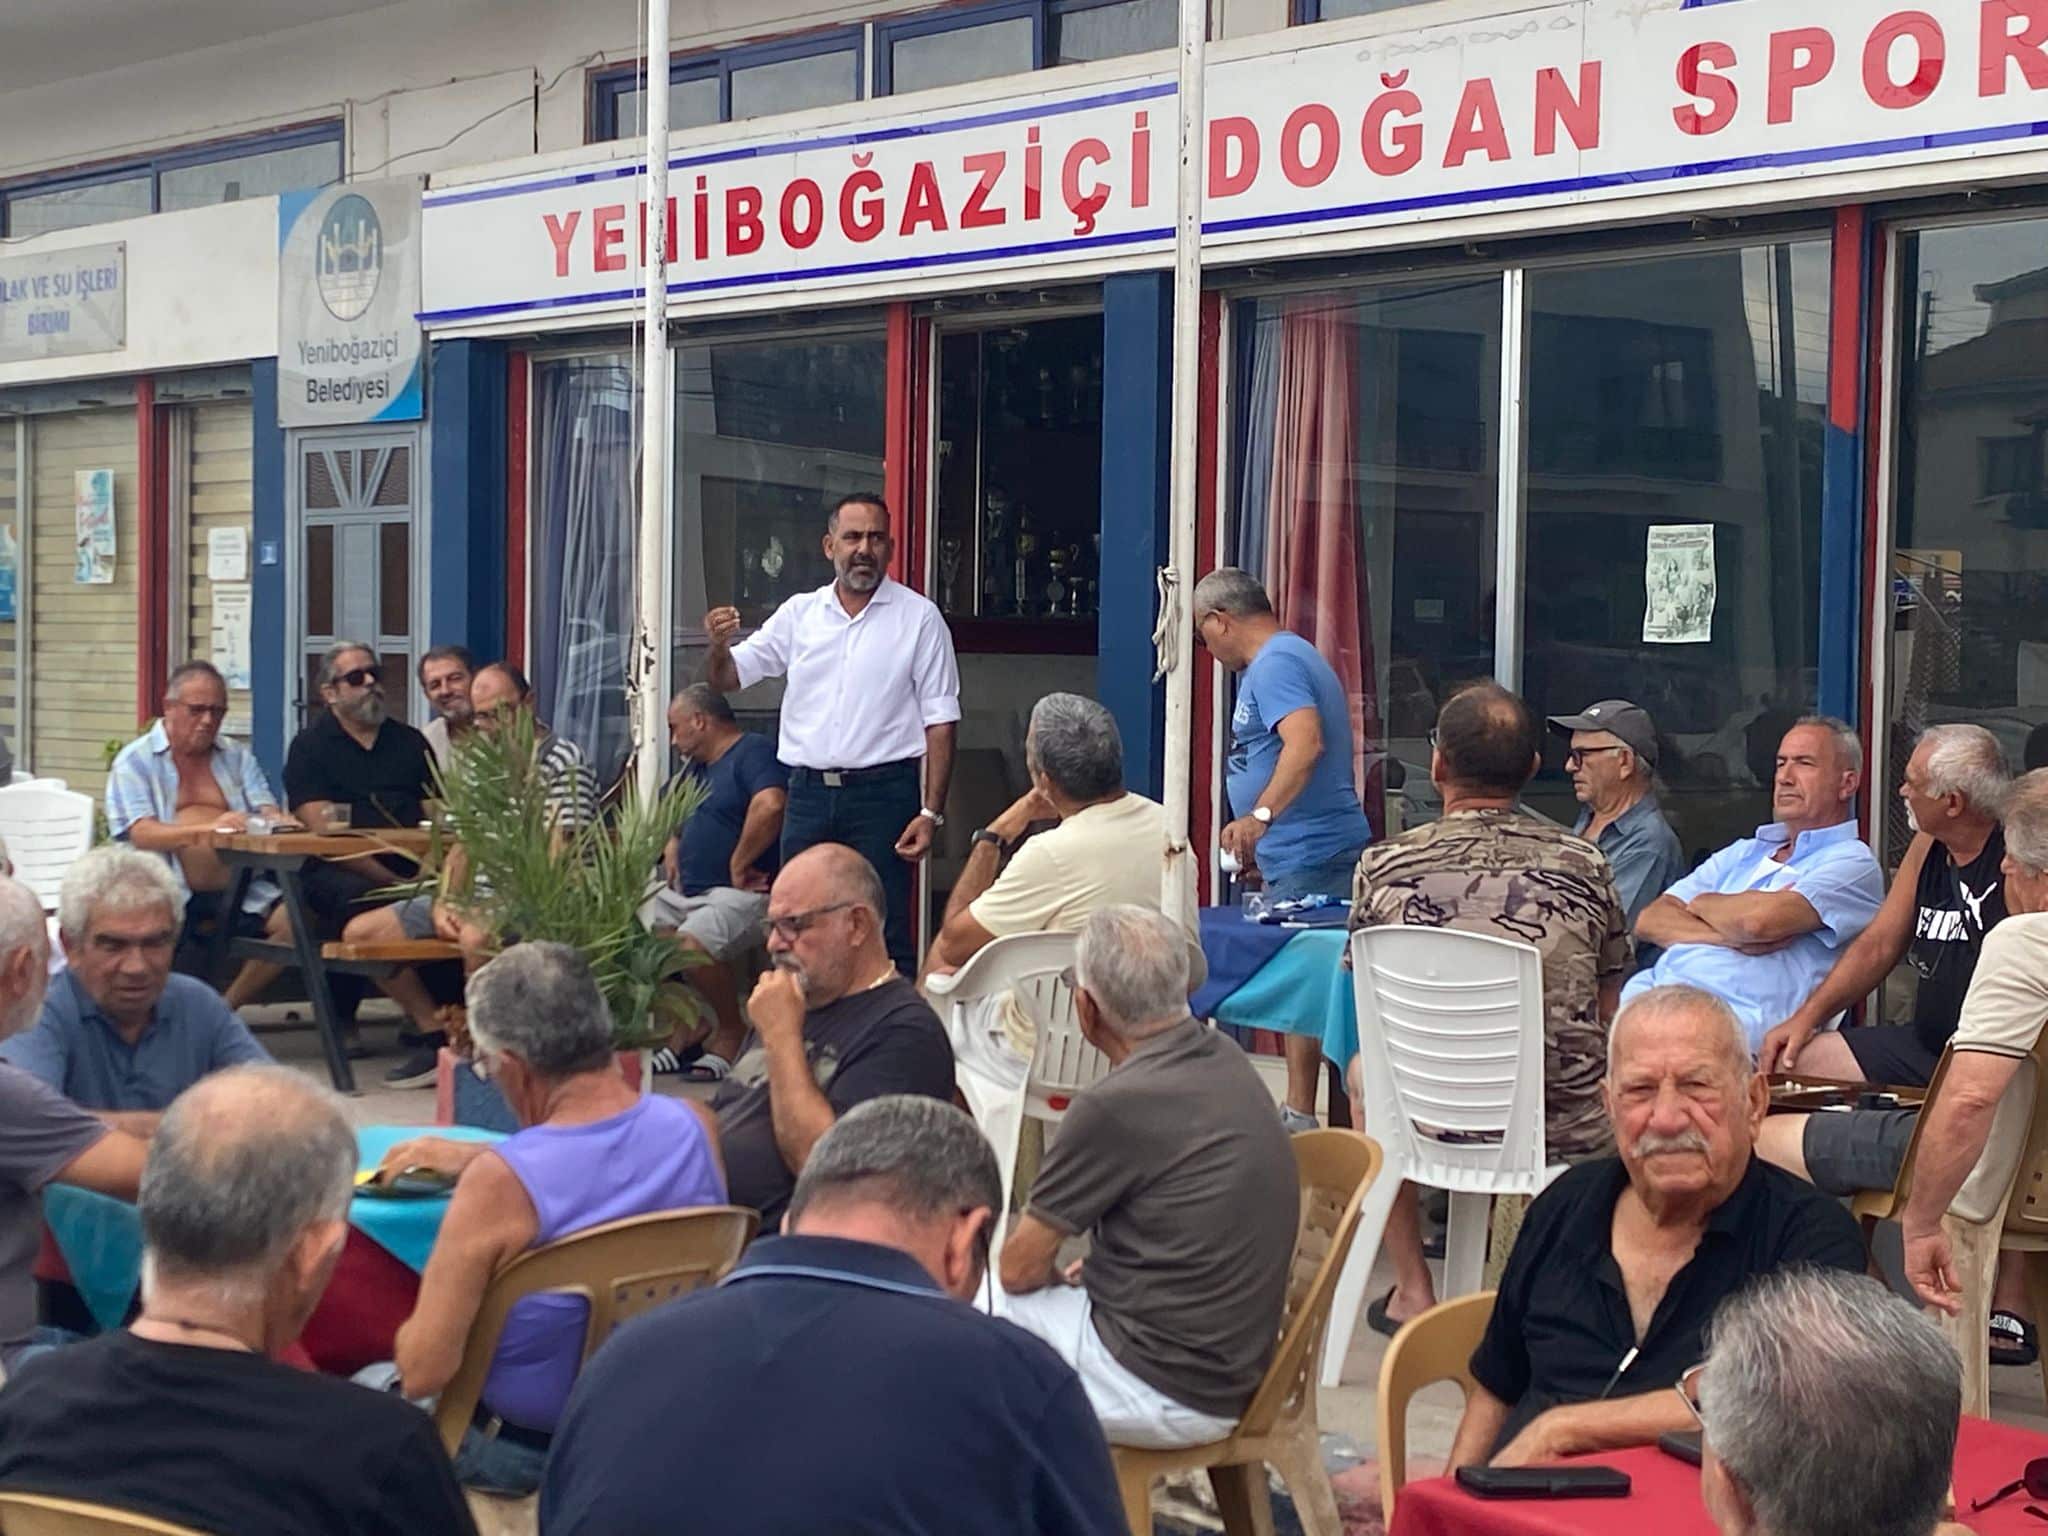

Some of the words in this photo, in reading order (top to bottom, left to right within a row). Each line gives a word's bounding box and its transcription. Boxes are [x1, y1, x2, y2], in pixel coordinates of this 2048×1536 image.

[1207, 61, 1601, 199] DOĞAN
[32, 276, 49, 299] VE
[53, 272, 72, 298] SU
[298, 331, 398, 365] Yeniboğaziçi
[306, 372, 389, 405] Belediyesi
